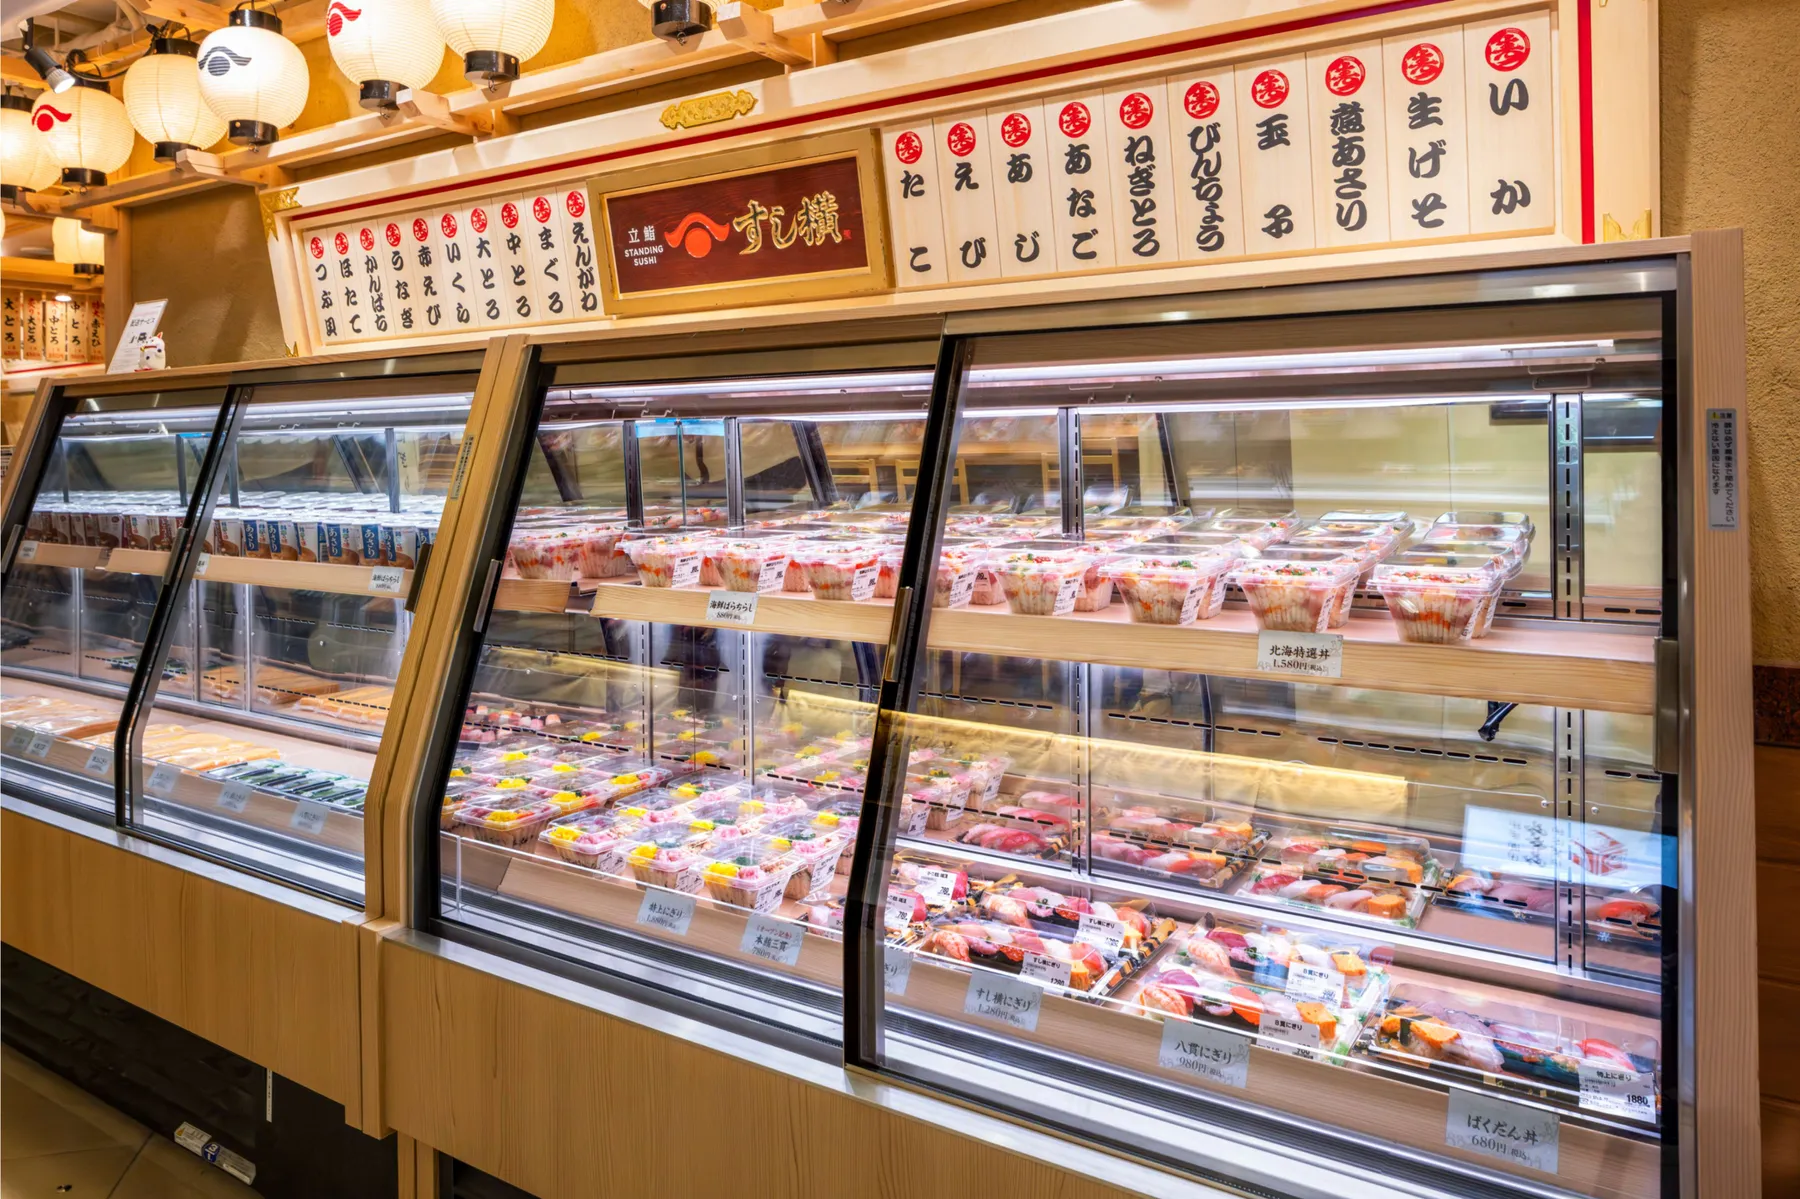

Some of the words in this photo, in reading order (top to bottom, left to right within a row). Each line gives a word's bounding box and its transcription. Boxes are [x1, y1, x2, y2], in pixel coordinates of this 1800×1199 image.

[1407, 92, 1447, 229] 生げそ
[1488, 78, 1531, 215] いか
[900, 170, 932, 272] たこ
[954, 162, 987, 268] えび
[1007, 153, 1040, 262] あじ
[1064, 143, 1099, 260] あなご
[1124, 135, 1160, 257] ねぎとろ
[1188, 122, 1225, 252] びんちょう
[538, 227, 563, 313] まぐろ
[572, 222, 598, 312] えんがわ
[624, 245, 664, 258] STANDING
[628, 225, 656, 244] 立鮨
[634, 256, 657, 266] SUSHI
[314, 264, 337, 337] つぶ貝
[339, 258, 362, 334] ほたて
[391, 250, 414, 328] うなぎ
[418, 245, 440, 326] 赤えび
[446, 242, 470, 324] いくら
[476, 237, 500, 320] 大とろ
[506, 232, 531, 318] 中とろ
[4, 298, 14, 342] 大とろ
[71, 301, 80, 345] 中とろ
[246, 525, 254, 550] あさり
[329, 528, 338, 555] あさり
[364, 529, 375, 557] あさり
[710, 600, 752, 612] 海鮮ばらちらし
[1270, 645, 1330, 660] 北海特選丼
[648, 902, 684, 918] 特上にぎり
[1175, 1040, 1232, 1064] 八貫にぎり
[1468, 1114, 1539, 1145] ばくだん丼
